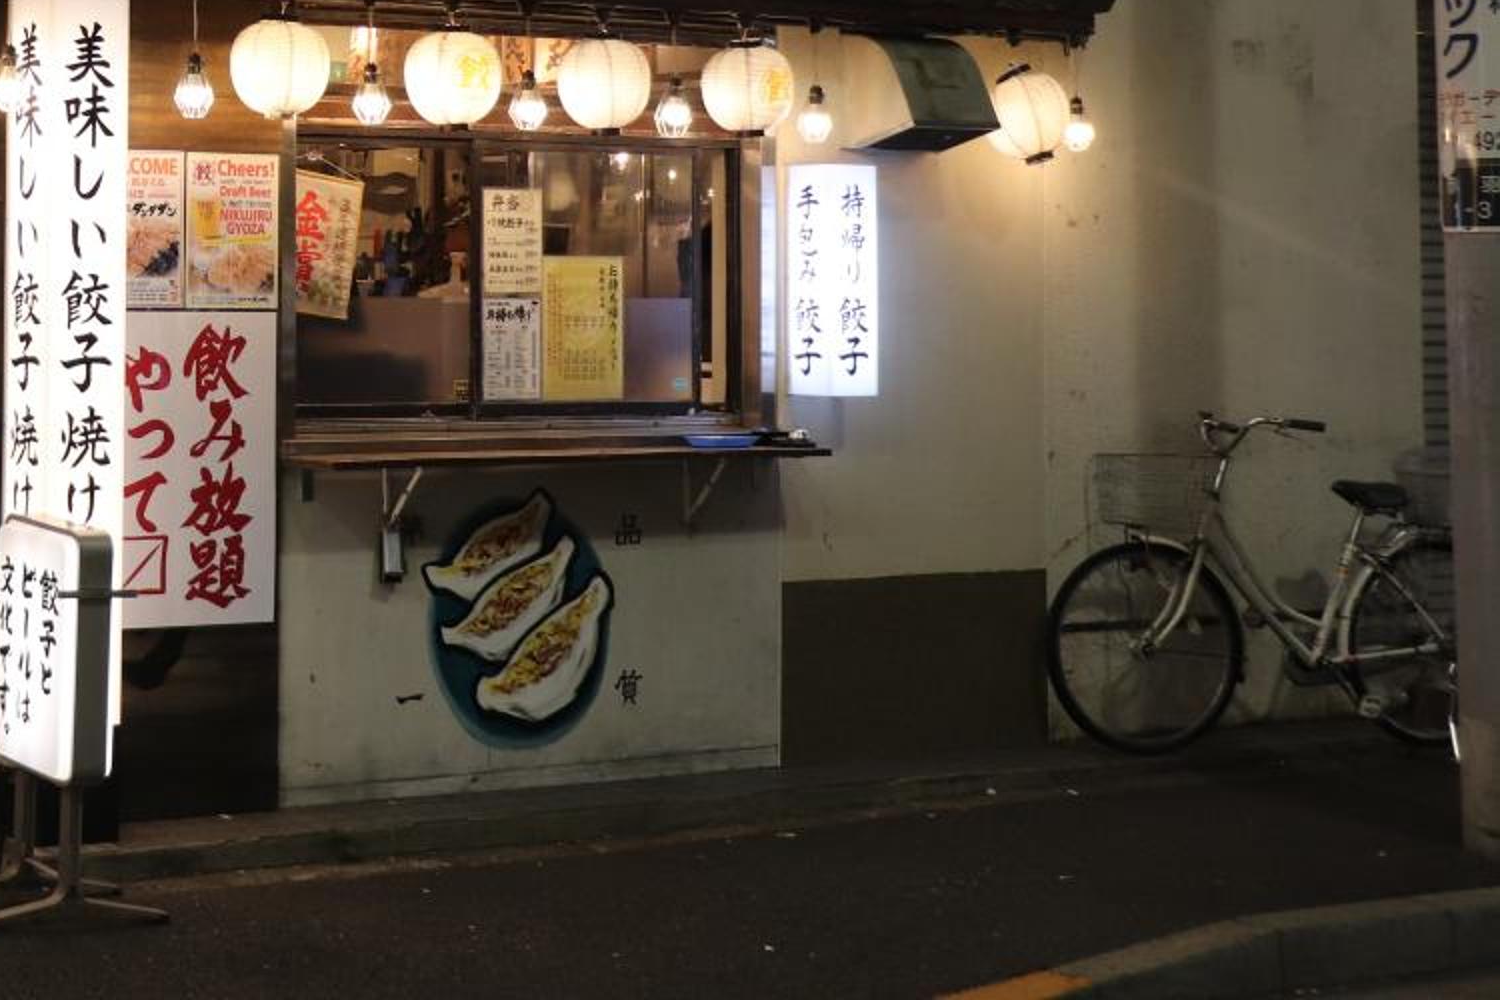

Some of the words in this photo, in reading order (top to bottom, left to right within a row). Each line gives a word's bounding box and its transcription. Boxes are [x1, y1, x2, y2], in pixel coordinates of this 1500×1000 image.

[218, 159, 275, 178] Cheers!
[227, 222, 266, 235] GYOZA
[60, 21, 115, 525] 美味しい餃子焼け
[181, 322, 253, 608] 飲み放題
